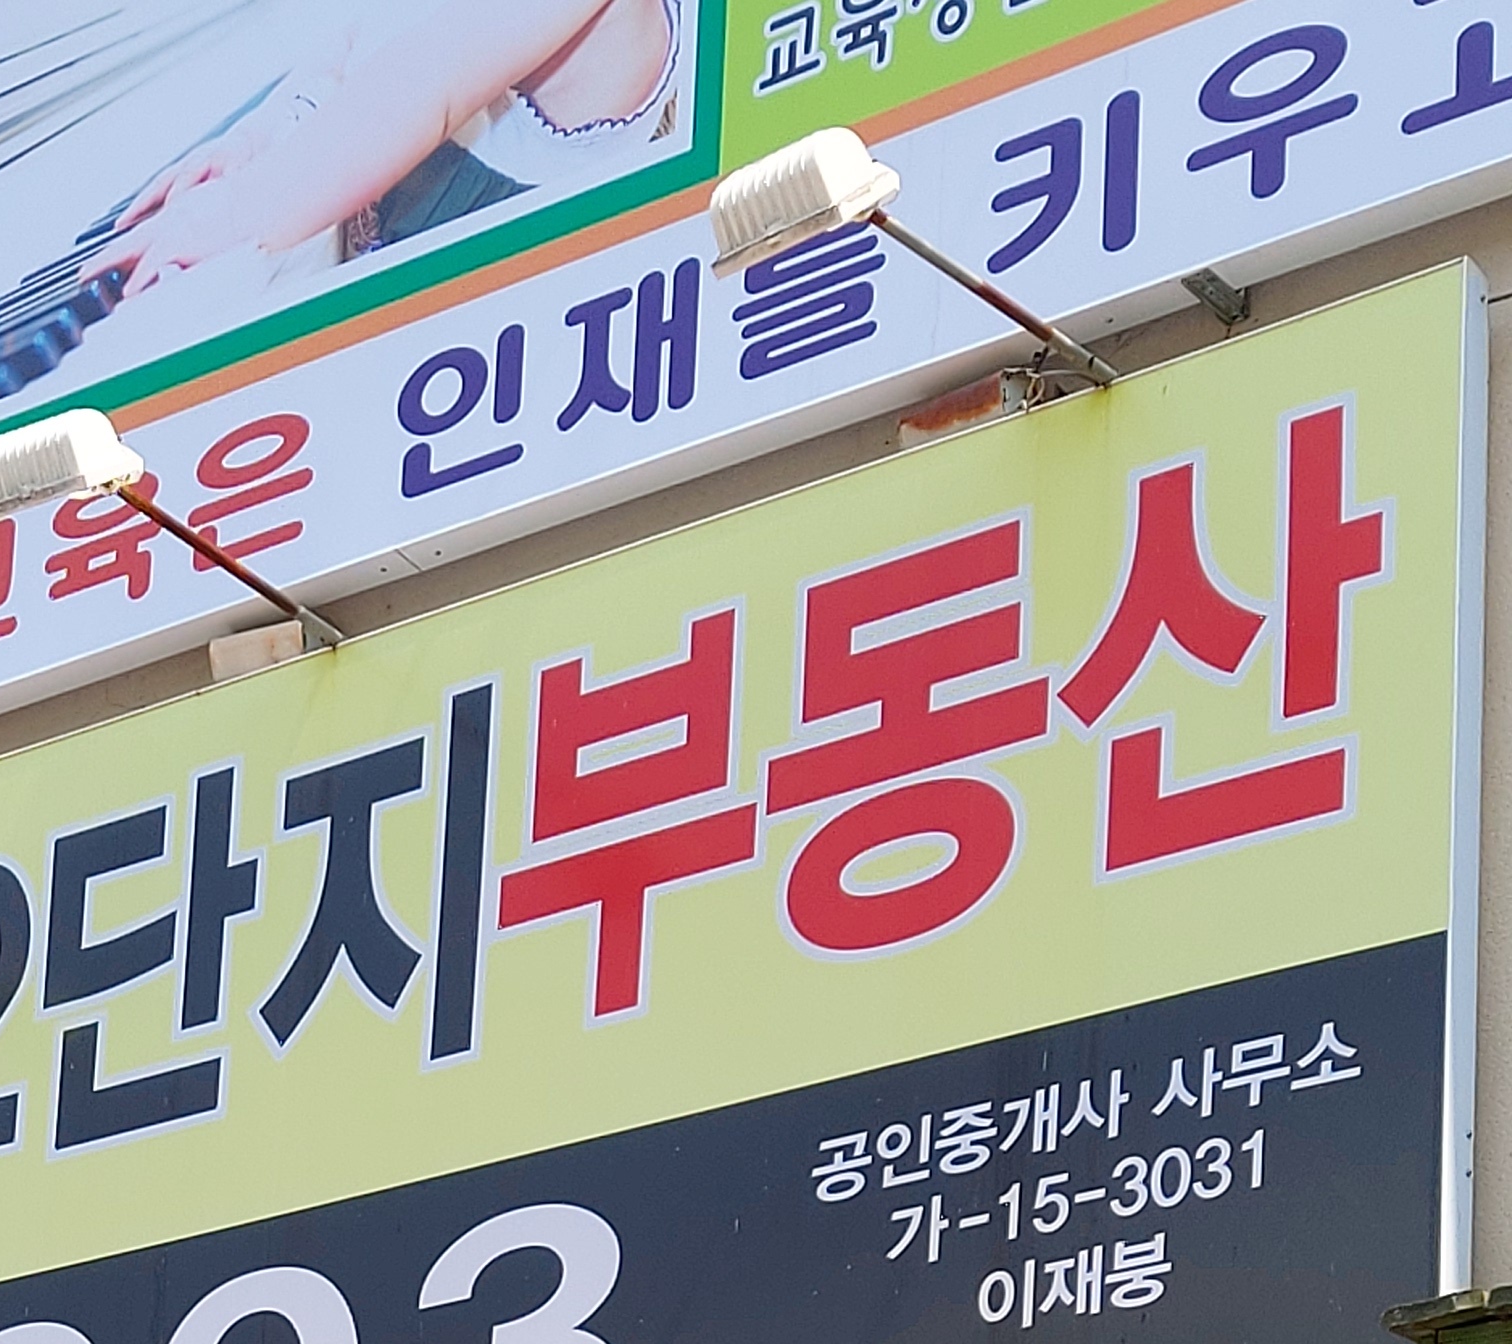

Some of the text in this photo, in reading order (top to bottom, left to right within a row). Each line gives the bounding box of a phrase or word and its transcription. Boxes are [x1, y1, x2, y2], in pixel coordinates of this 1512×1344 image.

[396, 220, 887, 499] 인재를
[496, 404, 1386, 1020] 부동산
[811, 1020, 1364, 1203] 공인중개사 사무소
[886, 1128, 1268, 1265] 가-15-3031
[978, 1232, 1173, 1329] 이재붕
